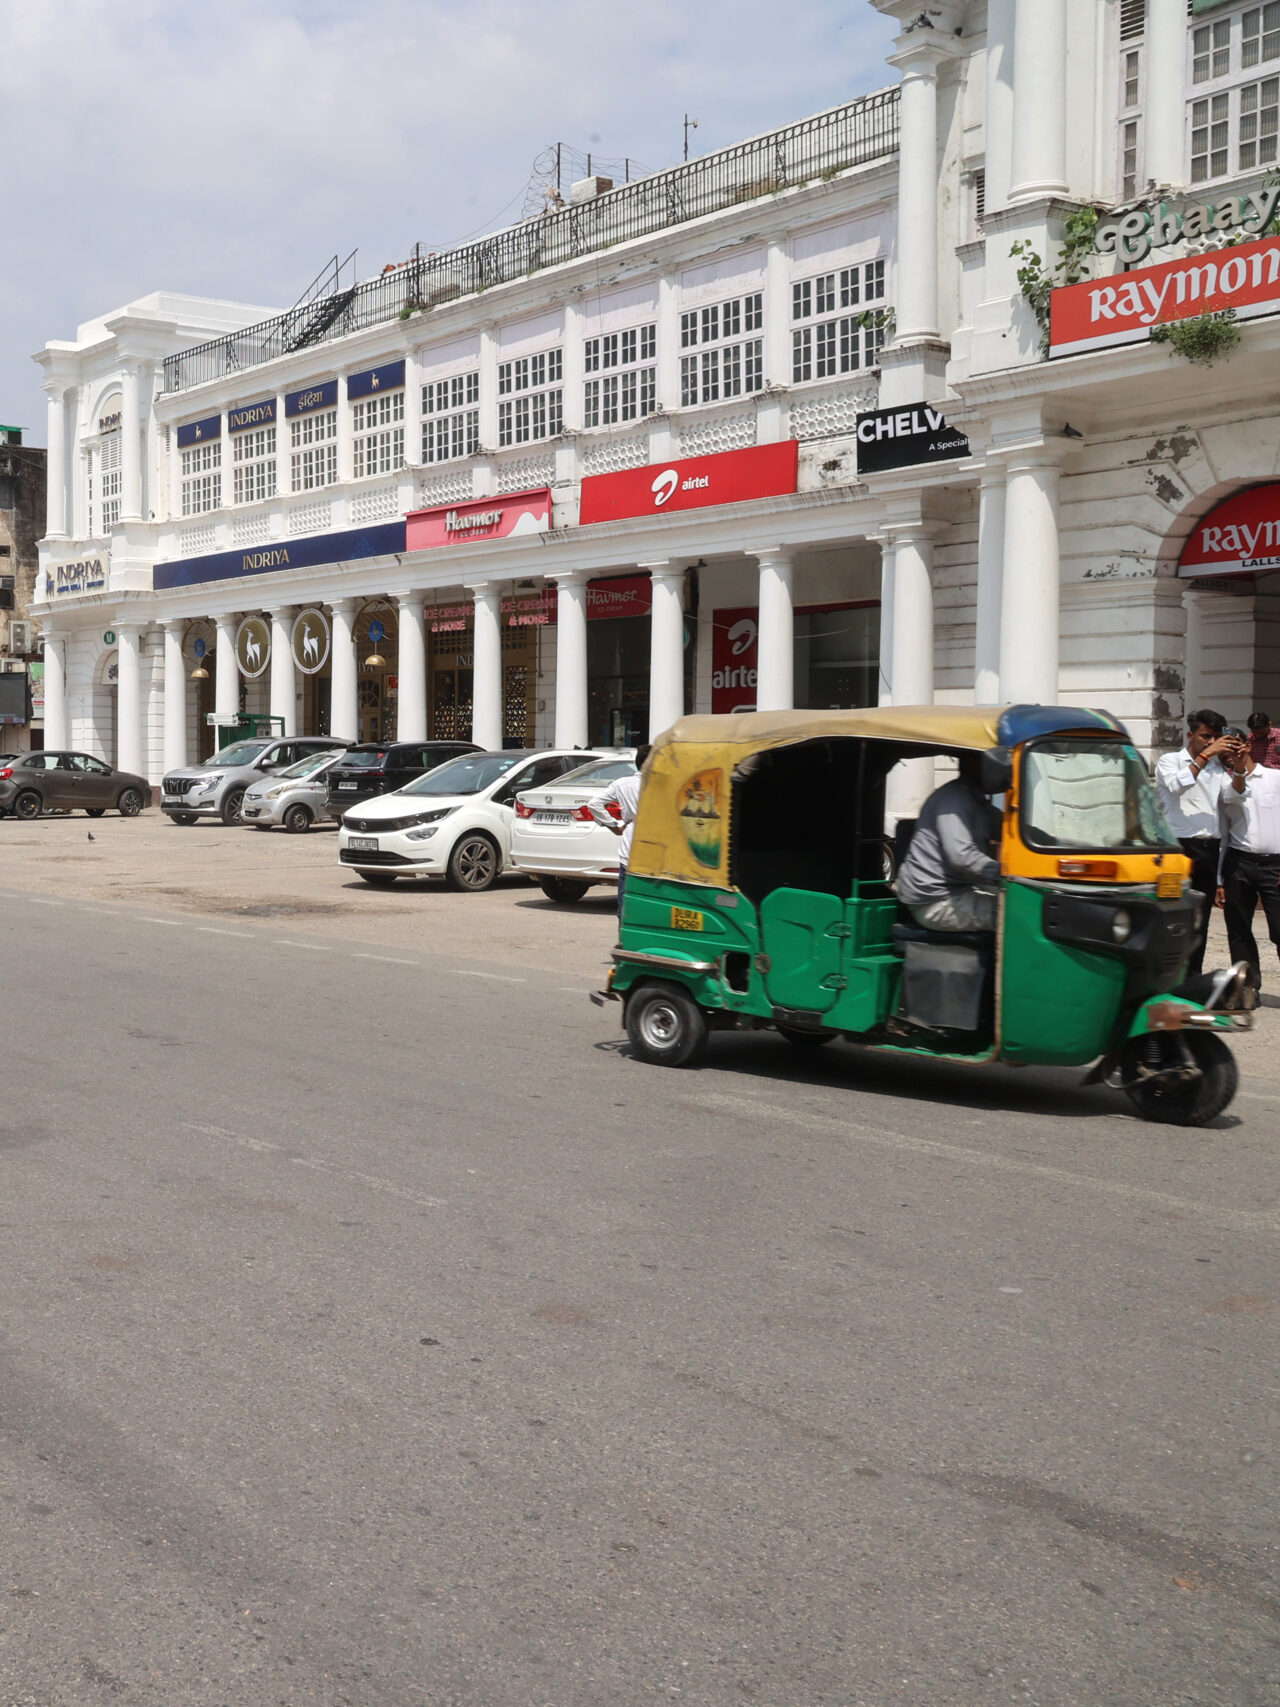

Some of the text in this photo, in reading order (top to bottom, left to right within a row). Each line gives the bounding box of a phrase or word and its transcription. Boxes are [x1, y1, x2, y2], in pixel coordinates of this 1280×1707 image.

[231, 404, 273, 428] INDRIYA
[857, 408, 943, 443] CHELV
[928, 443, 936, 451] A
[681, 475, 710, 491] airtel
[445, 508, 504, 532] Havmor
[242, 548, 290, 570] INDRIYA
[56, 558, 105, 582] INDRIYA
[586, 589, 638, 605] Havmor
[424, 608, 438, 619] ICE
[500, 601, 516, 613] ICE
[439, 620, 466, 632] MORE
[518, 613, 550, 626] MORE
